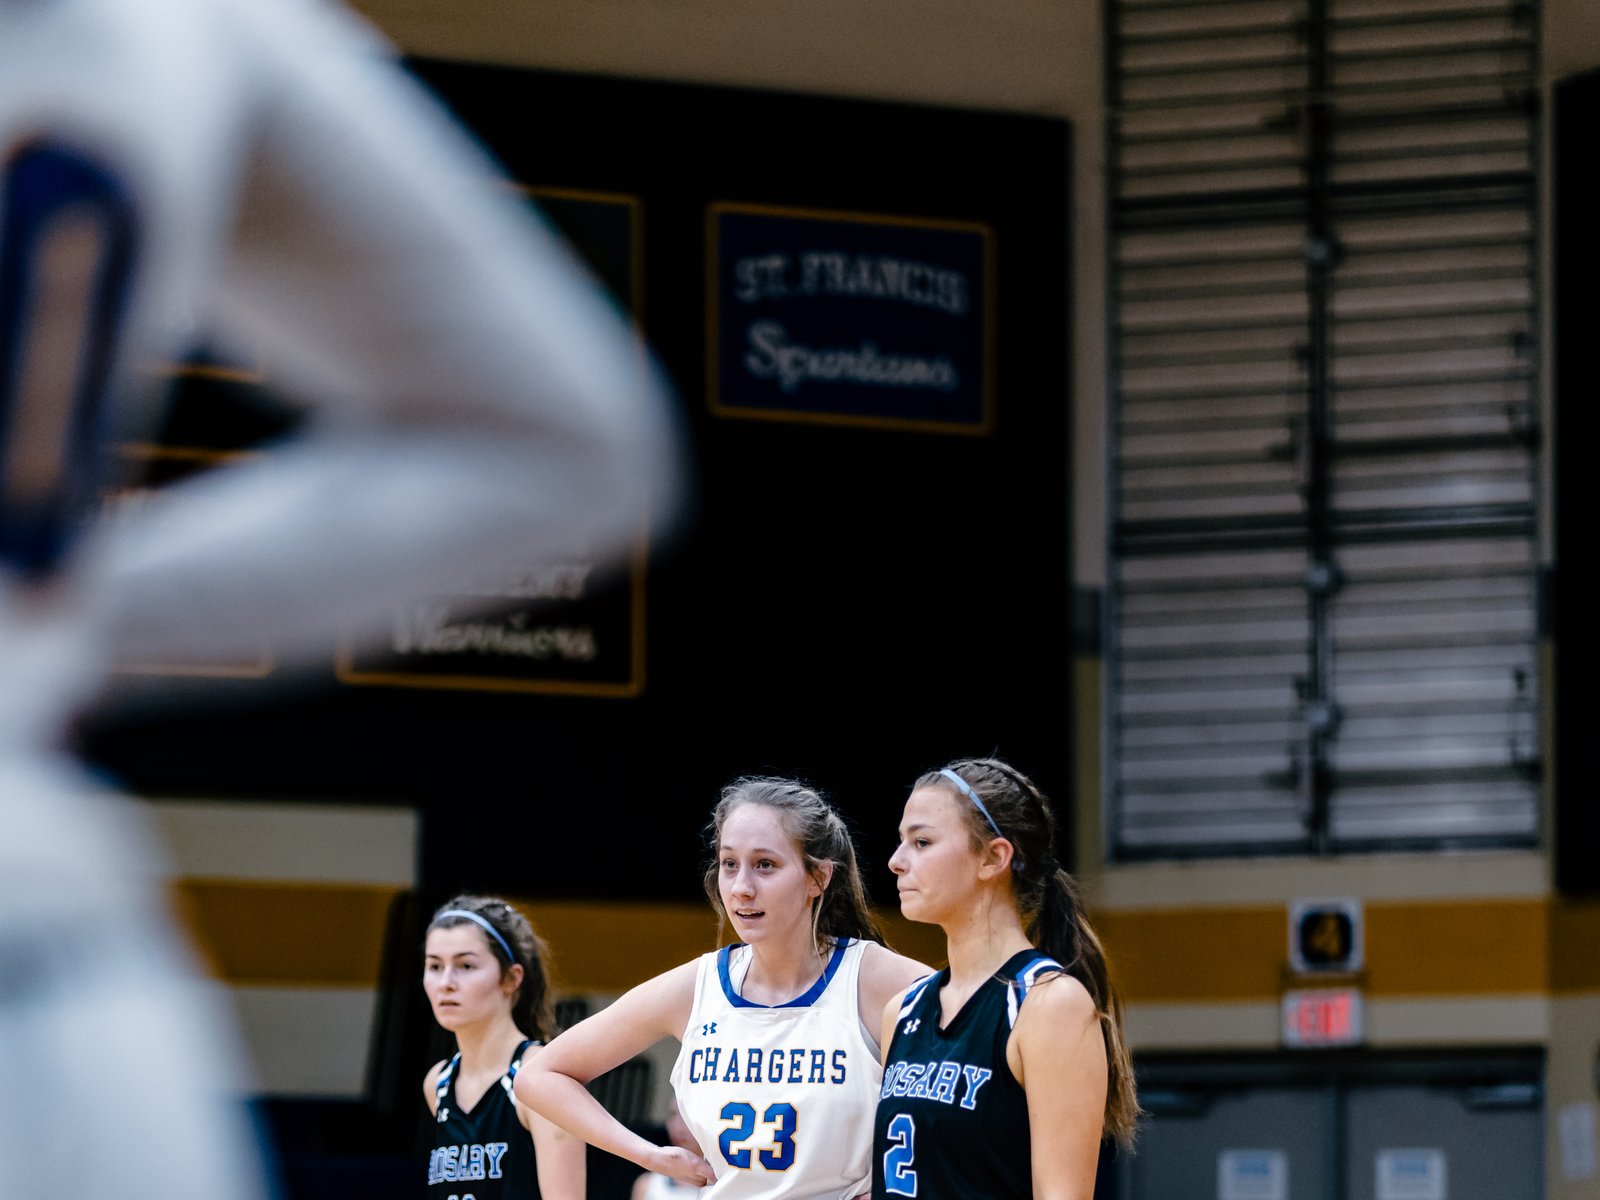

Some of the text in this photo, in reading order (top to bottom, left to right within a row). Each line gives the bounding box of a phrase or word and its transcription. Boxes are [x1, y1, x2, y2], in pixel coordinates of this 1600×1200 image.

[801, 250, 968, 315] FRANCIS
[743, 318, 959, 393] Spartans
[689, 1046, 848, 1085] CHARGERS
[881, 1061, 993, 1110] OSARY
[718, 1101, 799, 1172] 23
[884, 1113, 918, 1198] 2
